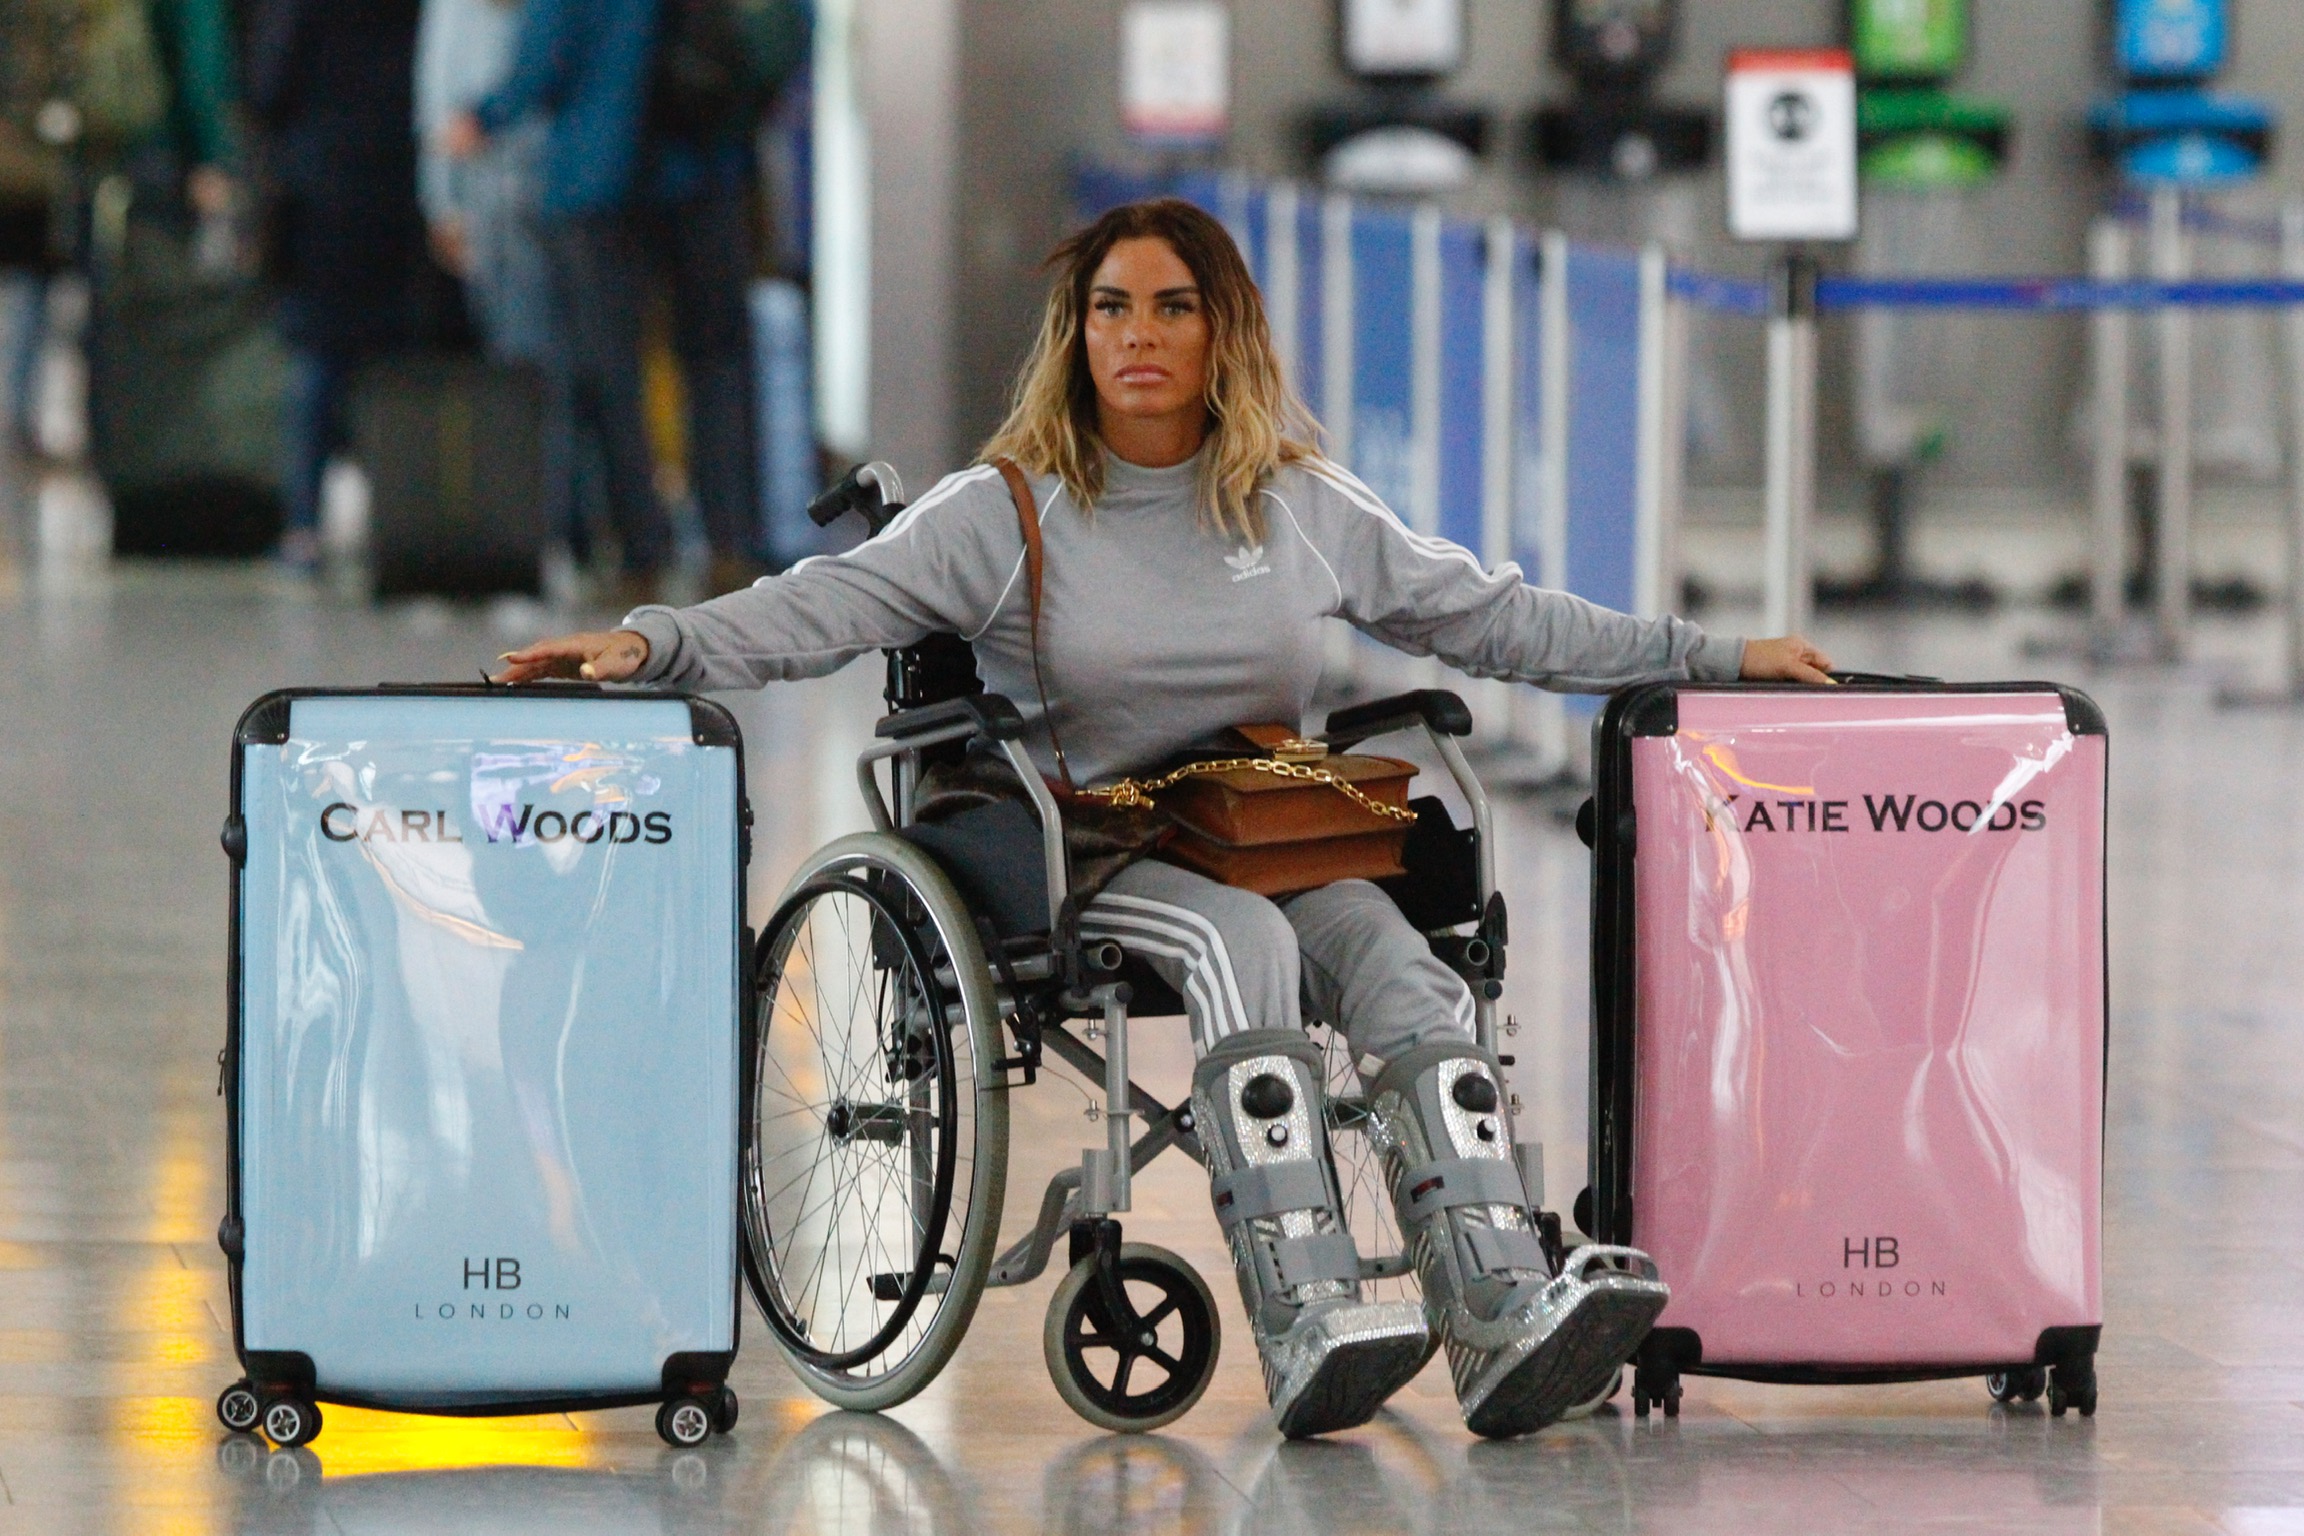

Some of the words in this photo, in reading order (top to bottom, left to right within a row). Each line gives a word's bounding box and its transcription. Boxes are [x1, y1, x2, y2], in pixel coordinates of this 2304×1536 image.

[320, 802, 463, 843] CARL
[477, 803, 673, 844] WOODS
[1862, 794, 2047, 833] WOODS
[1844, 1237, 1900, 1268] HB
[463, 1257, 522, 1290] HB
[1797, 1280, 1946, 1298] LONDON
[415, 1303, 570, 1320] LONDON
